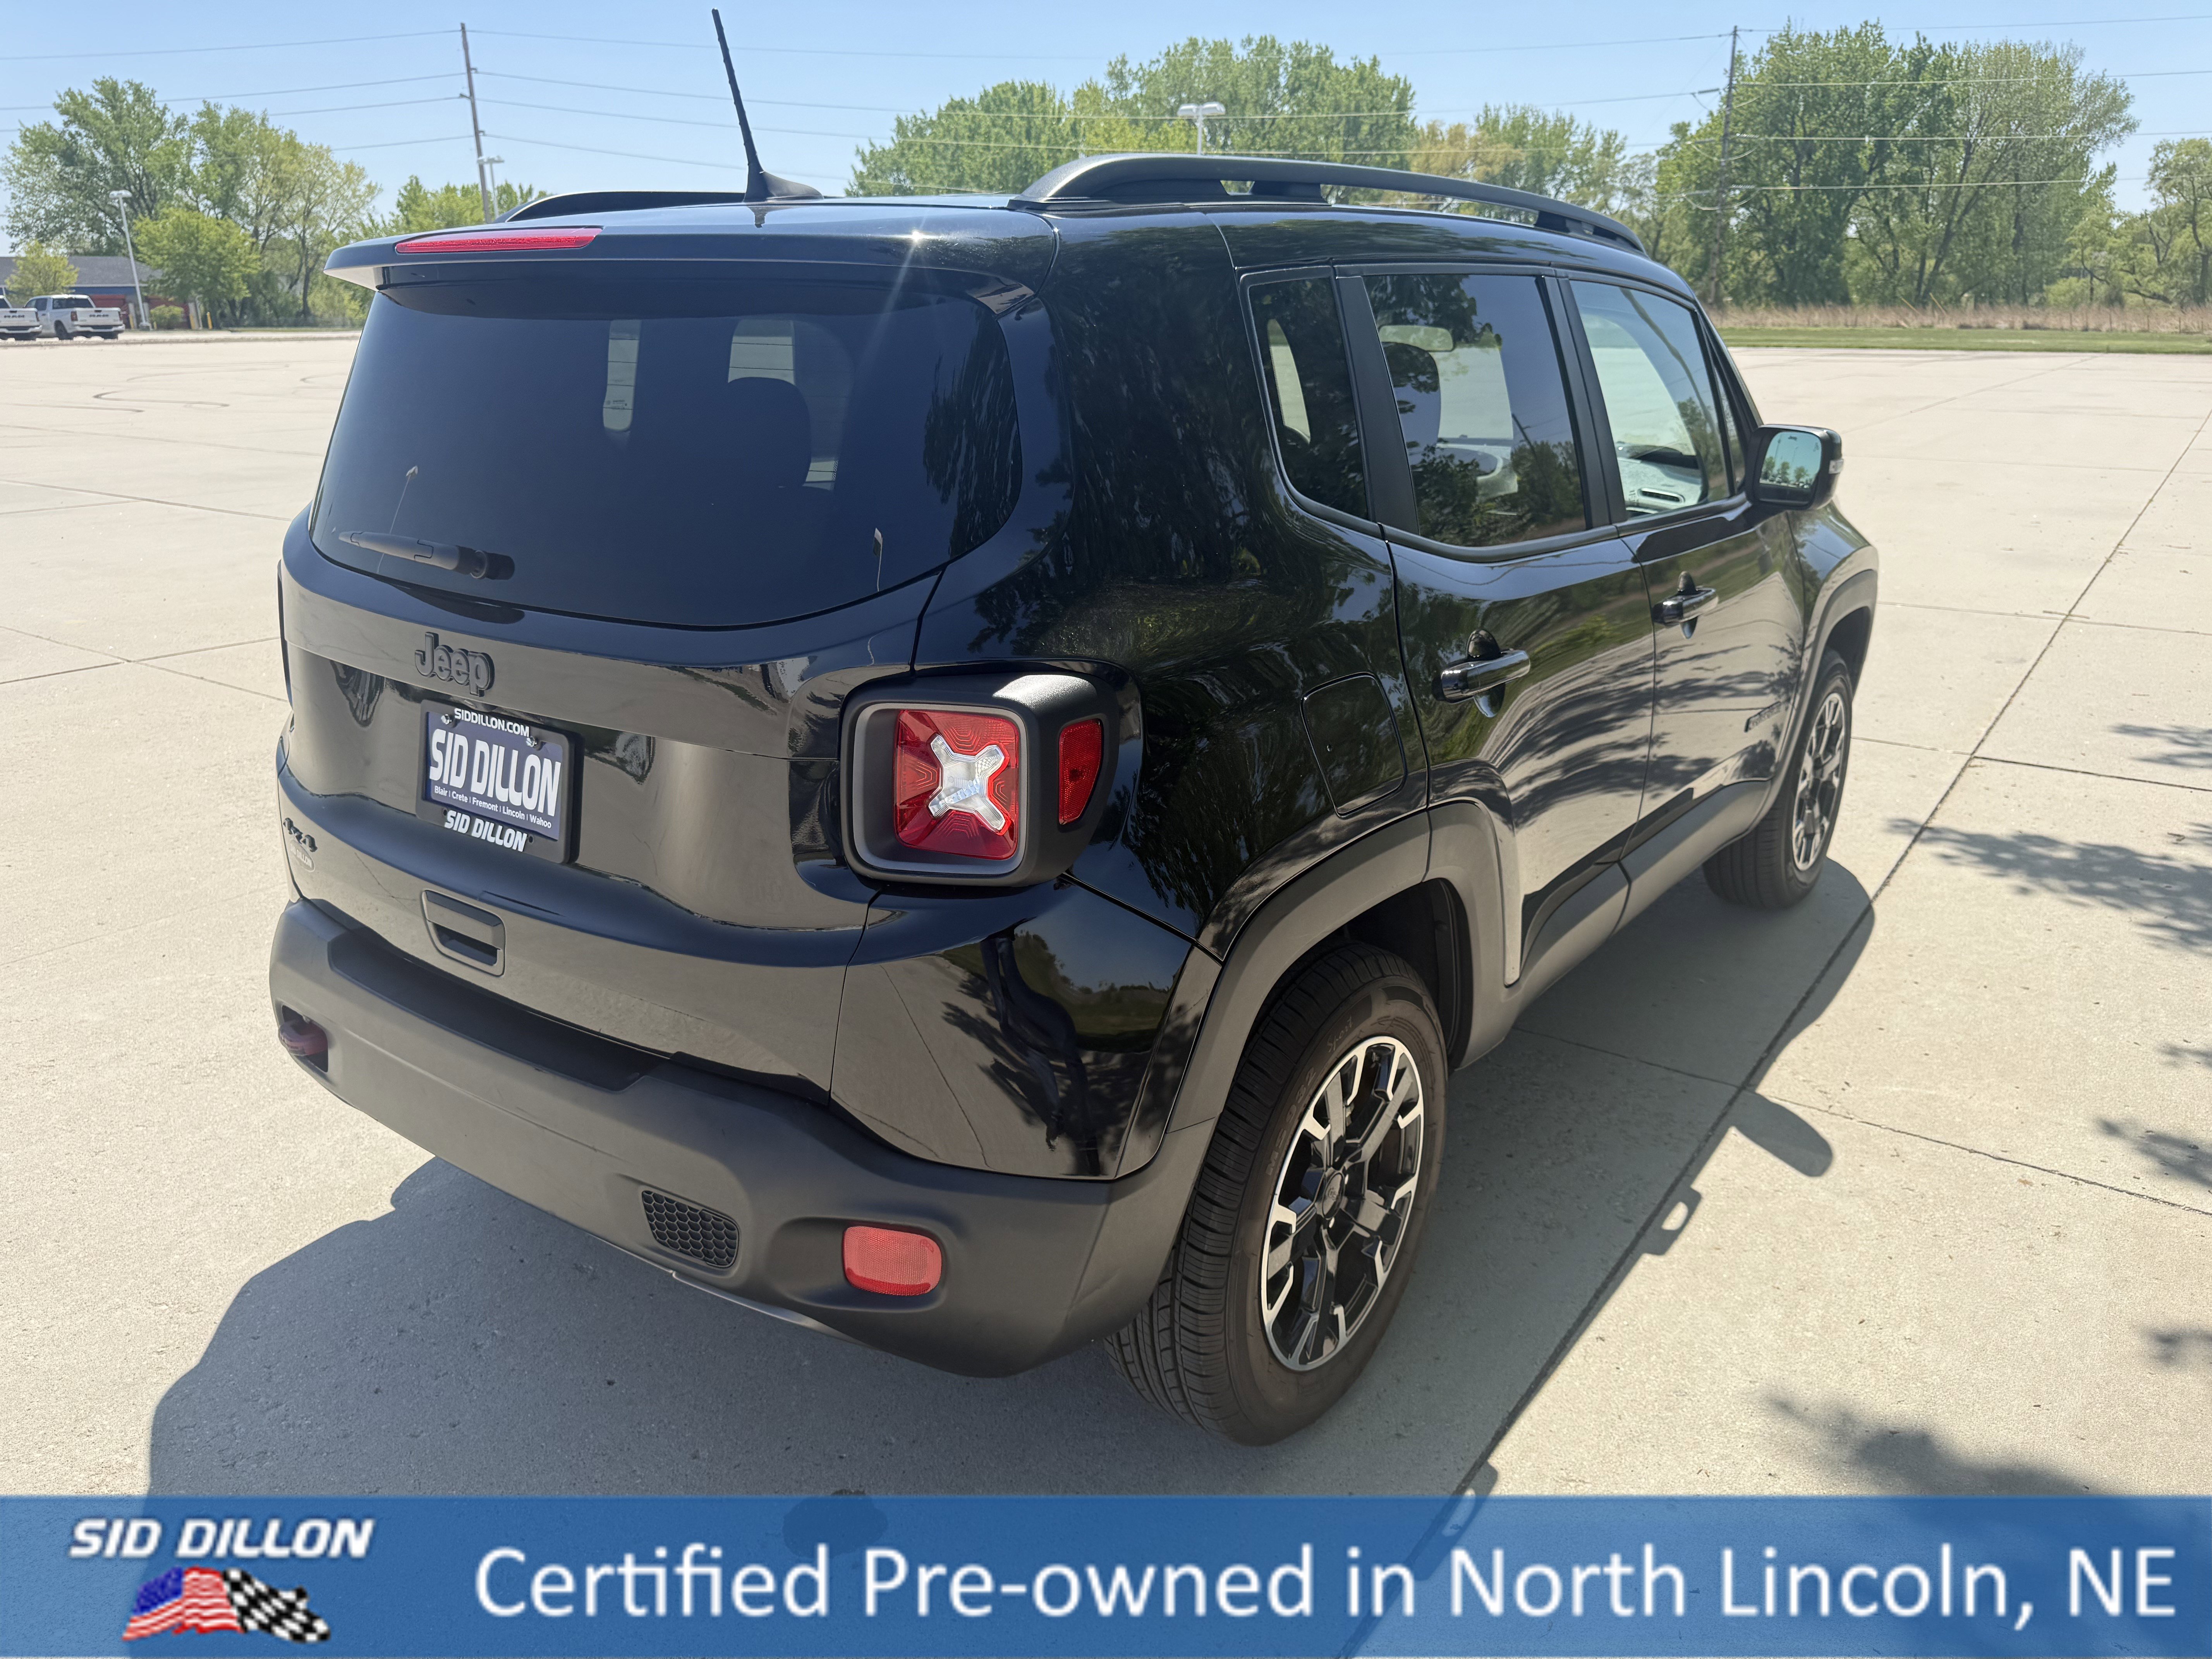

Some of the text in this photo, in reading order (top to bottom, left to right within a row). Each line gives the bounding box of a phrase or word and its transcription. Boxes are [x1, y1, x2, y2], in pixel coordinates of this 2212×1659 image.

[415, 632, 495, 697] Jeep
[454, 707, 530, 737] SIDDILLON.COM
[429, 728, 562, 817] SID DILLON
[434, 785, 552, 829] Blair Crete Fremont Lincoln Wahoo
[444, 810, 527, 852] SID DILLON
